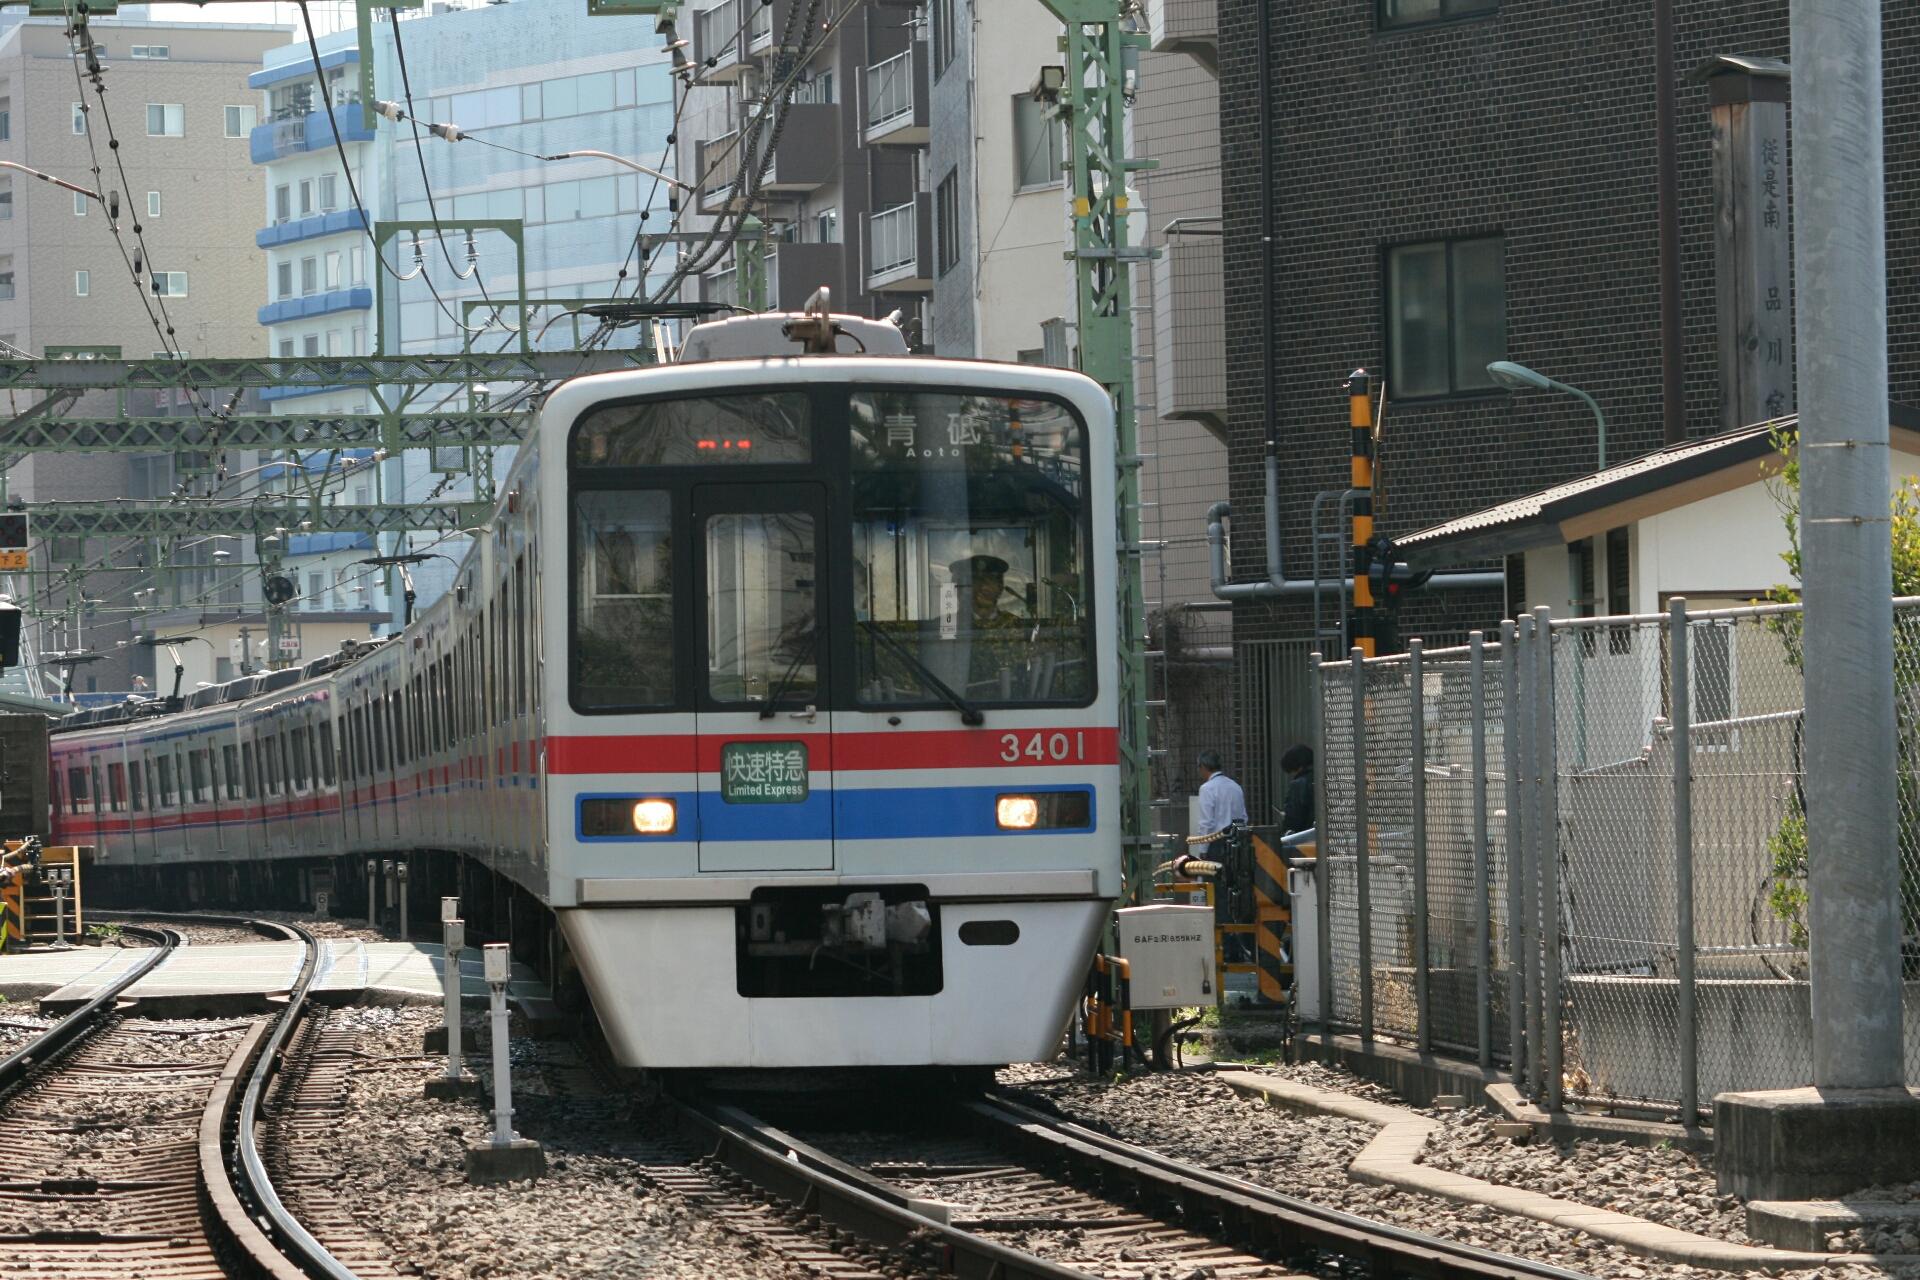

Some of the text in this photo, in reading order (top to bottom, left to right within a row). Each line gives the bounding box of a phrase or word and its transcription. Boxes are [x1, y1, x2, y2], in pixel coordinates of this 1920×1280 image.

[883, 412, 981, 447] 青砥
[906, 447, 960, 457] Aoto
[1000, 732, 1084, 762] 3401
[726, 750, 805, 783] 快速特急
[728, 783, 804, 798] Limited Express
